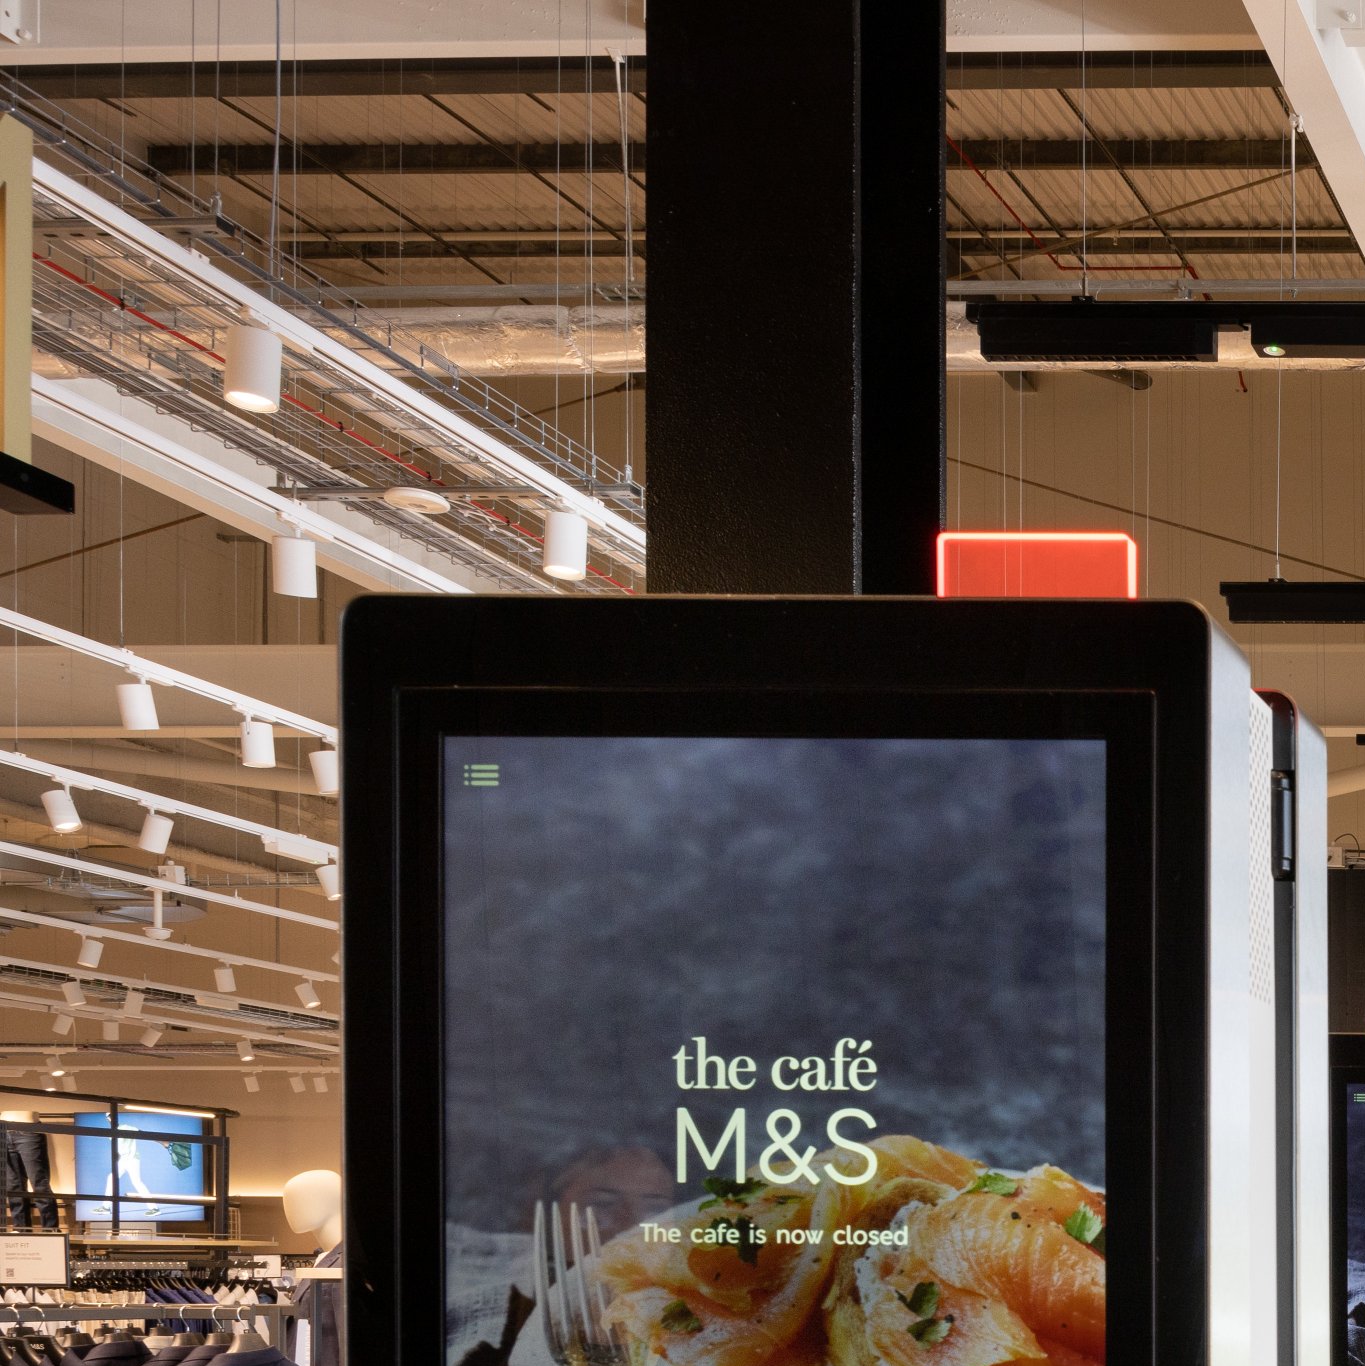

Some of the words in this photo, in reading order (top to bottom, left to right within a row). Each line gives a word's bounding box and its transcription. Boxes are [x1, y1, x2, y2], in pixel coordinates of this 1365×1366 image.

[672, 1036, 757, 1091] the
[771, 1037, 878, 1091] café
[676, 1106, 878, 1186] M&S
[640, 1223, 681, 1243] The
[690, 1224, 740, 1244] cafe
[749, 1224, 767, 1244] is
[776, 1229, 824, 1244] now
[833, 1225, 909, 1246] closed
